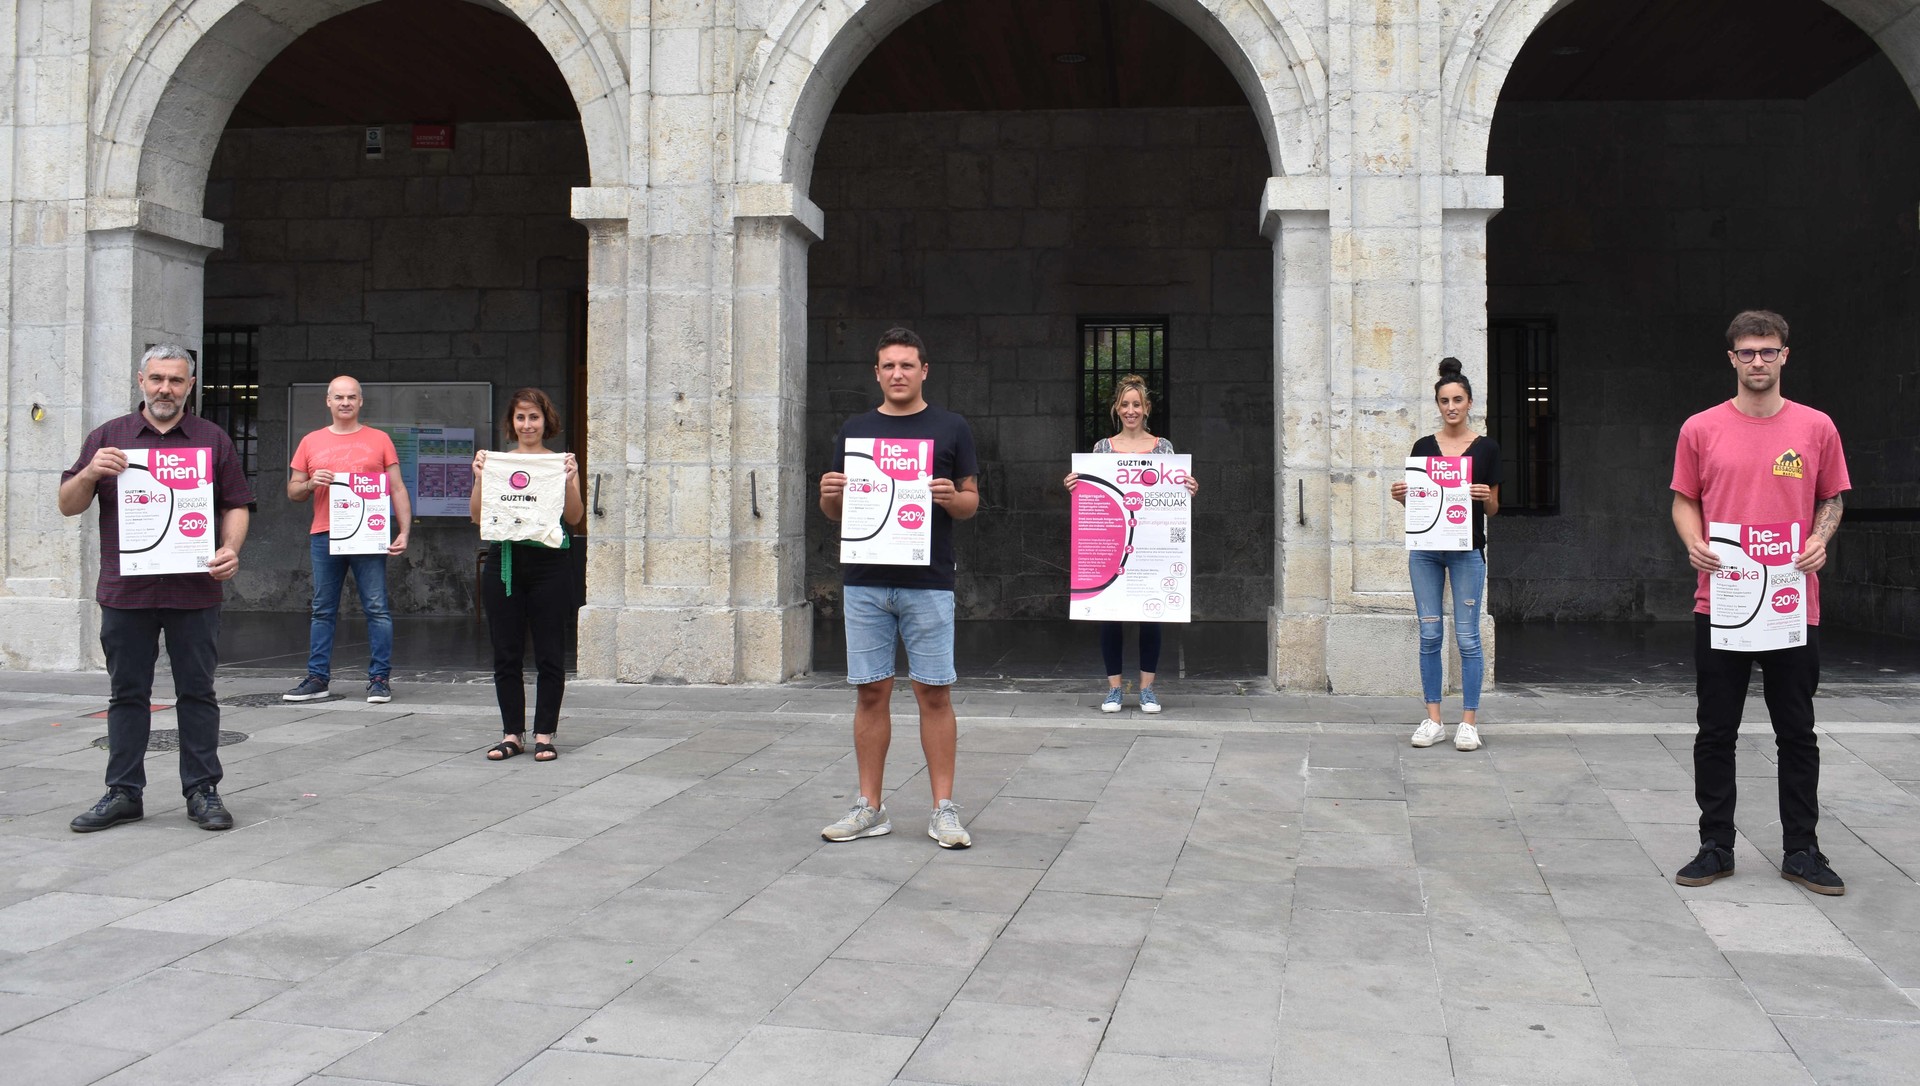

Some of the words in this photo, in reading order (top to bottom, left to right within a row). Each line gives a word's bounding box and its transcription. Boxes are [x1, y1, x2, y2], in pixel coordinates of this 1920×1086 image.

[880, 440, 908, 457] he-
[156, 450, 186, 466] he-
[1431, 458, 1452, 470] he-
[354, 474, 373, 484] he-
[1116, 463, 1188, 486] azoka
[849, 480, 888, 493] azoka
[124, 491, 166, 504] azoka
[1410, 488, 1438, 498] azoka
[334, 500, 360, 509] azoka
[1122, 496, 1144, 506] -20%
[1145, 499, 1187, 507] BONUAK
[898, 511, 925, 522] -20%
[1446, 510, 1467, 518] -20%
[178, 519, 207, 530] -20%
[1749, 526, 1780, 543] he-
[1716, 568, 1759, 581] azoka
[1771, 577, 1800, 585] BONUAK
[1772, 594, 1800, 607] -20%
